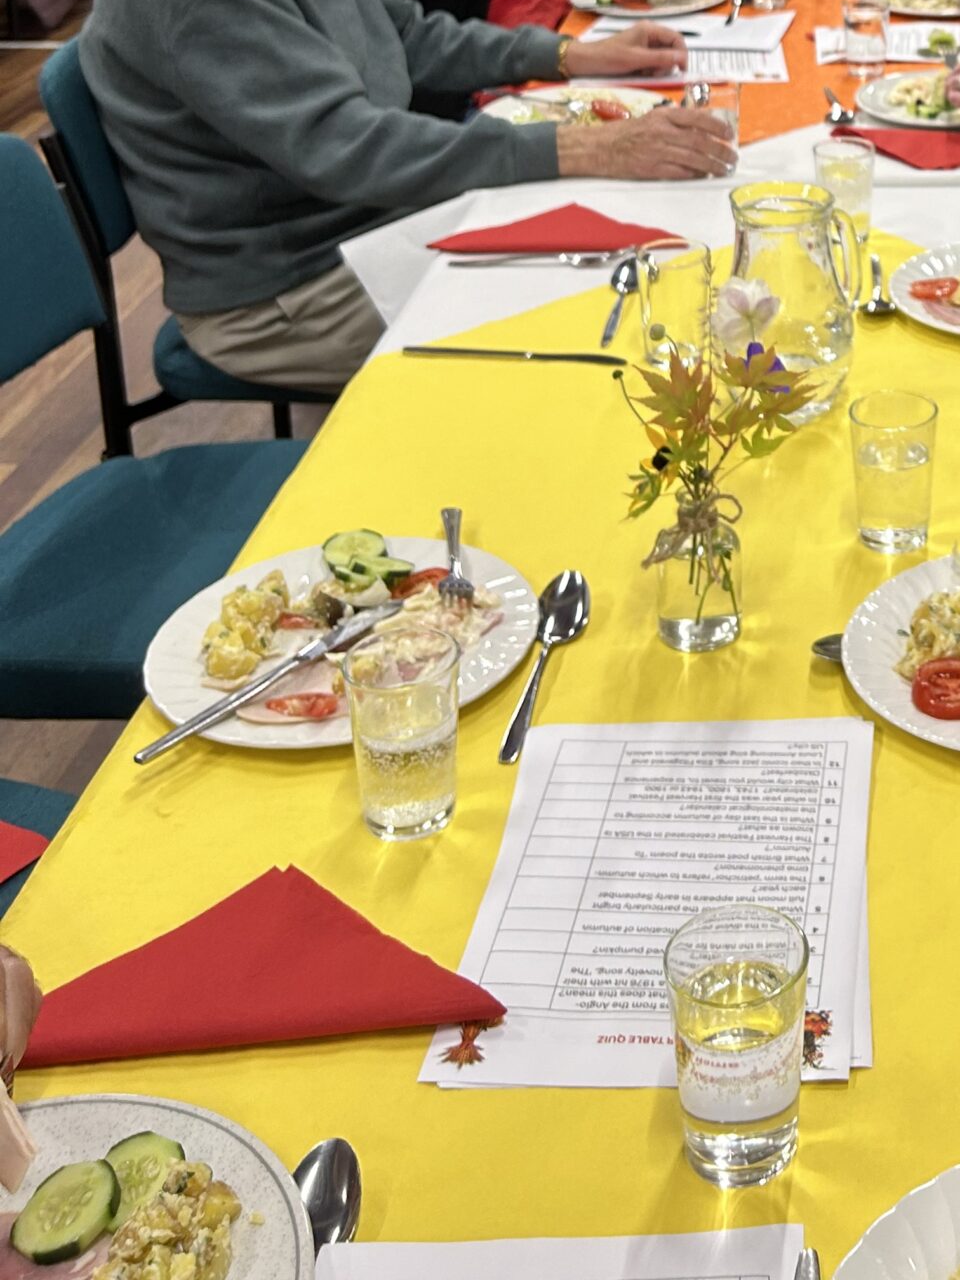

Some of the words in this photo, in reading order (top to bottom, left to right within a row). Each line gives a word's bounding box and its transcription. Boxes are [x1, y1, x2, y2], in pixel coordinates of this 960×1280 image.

[650, 850, 678, 858] poem
[598, 892, 653, 901] September
[655, 893, 679, 901] early
[592, 902, 621, 910] bright
[624, 903, 680, 912] particularly
[592, 946, 644, 954] pumpkin?
[625, 968, 662, 976] novelty
[563, 978, 588, 986] their
[590, 978, 612, 986] with
[558, 990, 596, 998] mean?
[598, 990, 617, 998] this
[620, 990, 646, 998] does
[612, 1001, 629, 1010] the
[632, 1001, 656, 1010] from
[597, 1034, 626, 1044] QUIZ
[628, 1036, 664, 1044] TABLE
